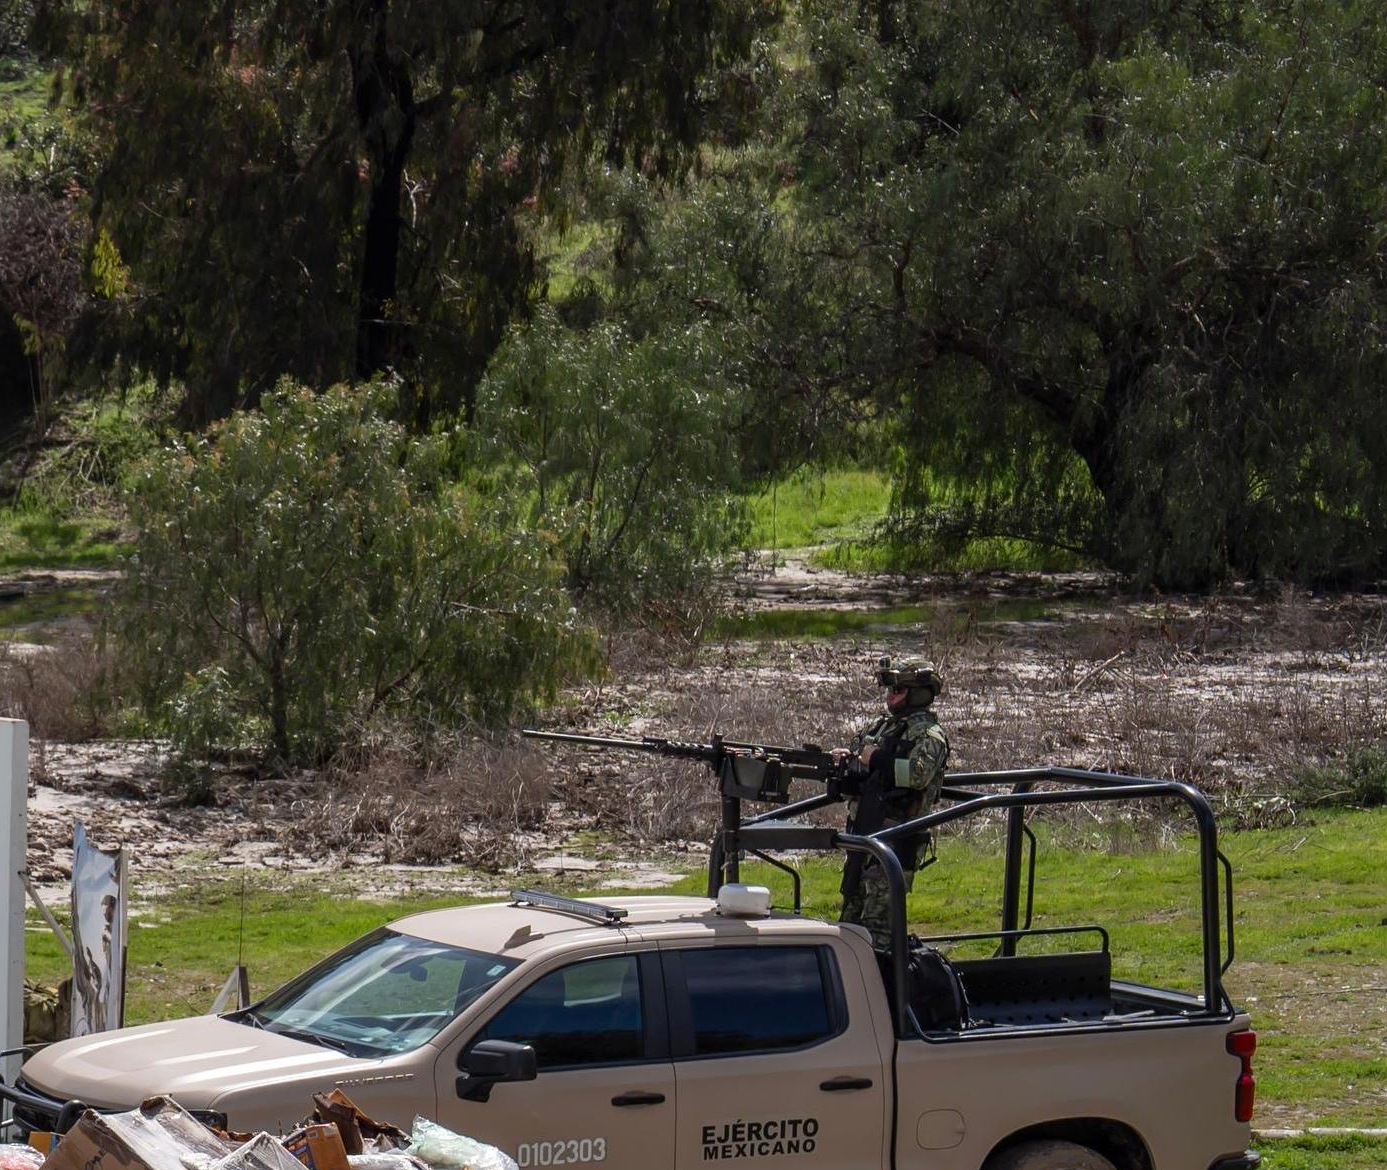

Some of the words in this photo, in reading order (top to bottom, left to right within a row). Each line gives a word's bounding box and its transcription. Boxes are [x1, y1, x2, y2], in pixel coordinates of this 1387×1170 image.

[701, 1118, 819, 1146] EJÉRCITO
[517, 1137, 607, 1168] 0102303
[703, 1138, 817, 1161] MEXICANO
